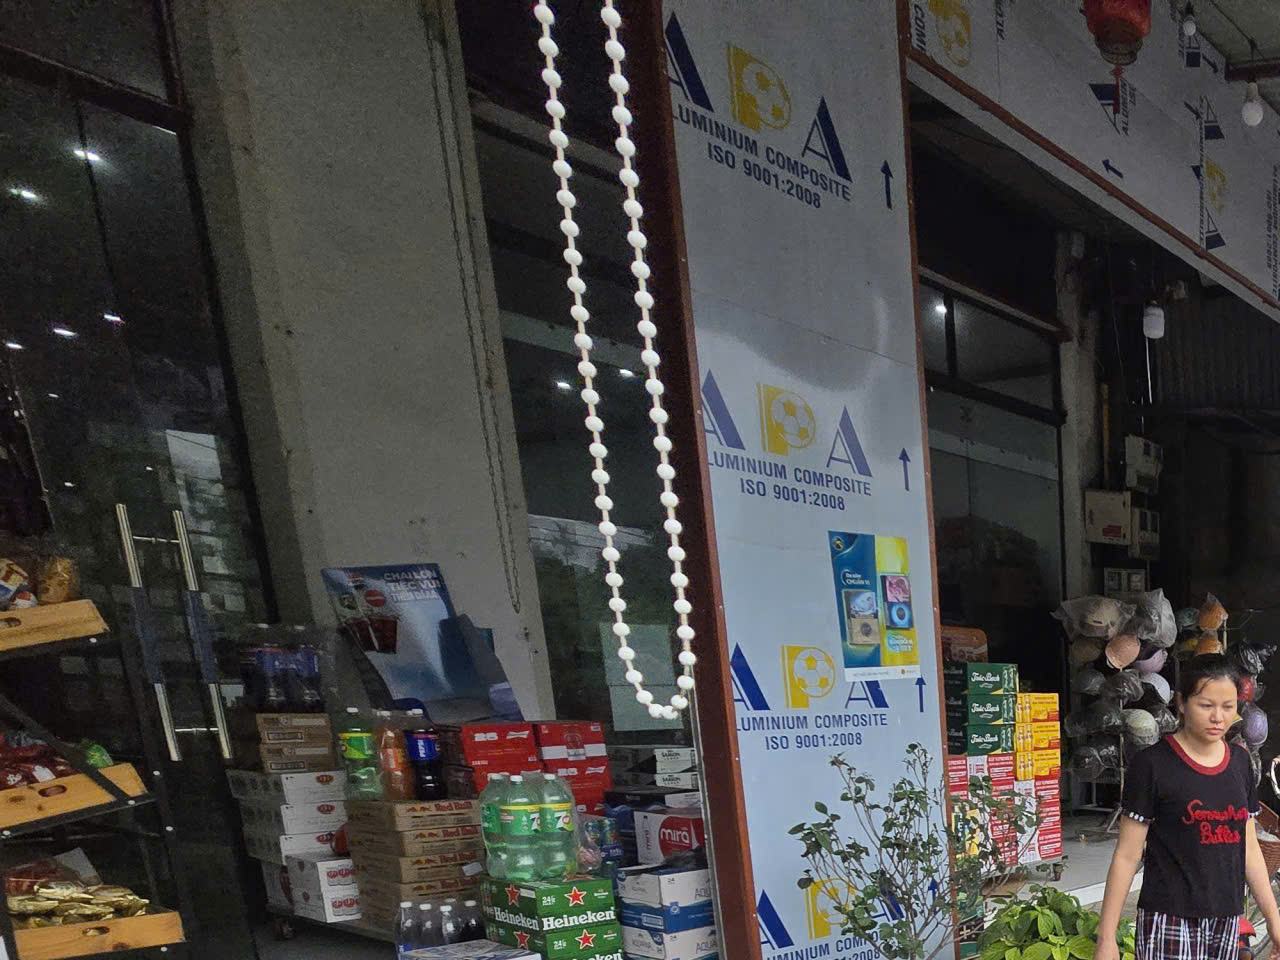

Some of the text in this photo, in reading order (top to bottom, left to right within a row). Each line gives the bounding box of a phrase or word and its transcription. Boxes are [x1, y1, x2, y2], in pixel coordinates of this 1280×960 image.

[707, 142, 823, 210] ISO 9001:2008
[765, 146, 852, 203] COMPOSITE
[740, 477, 846, 512] ISO 9001:2008
[794, 467, 872, 497] COMPOSITE
[815, 713, 888, 729] COMPOSITE
[765, 732, 863, 751] ISO 9001:2008
[494, 907, 539, 931] Heineken
[542, 908, 616, 931] Heineken
